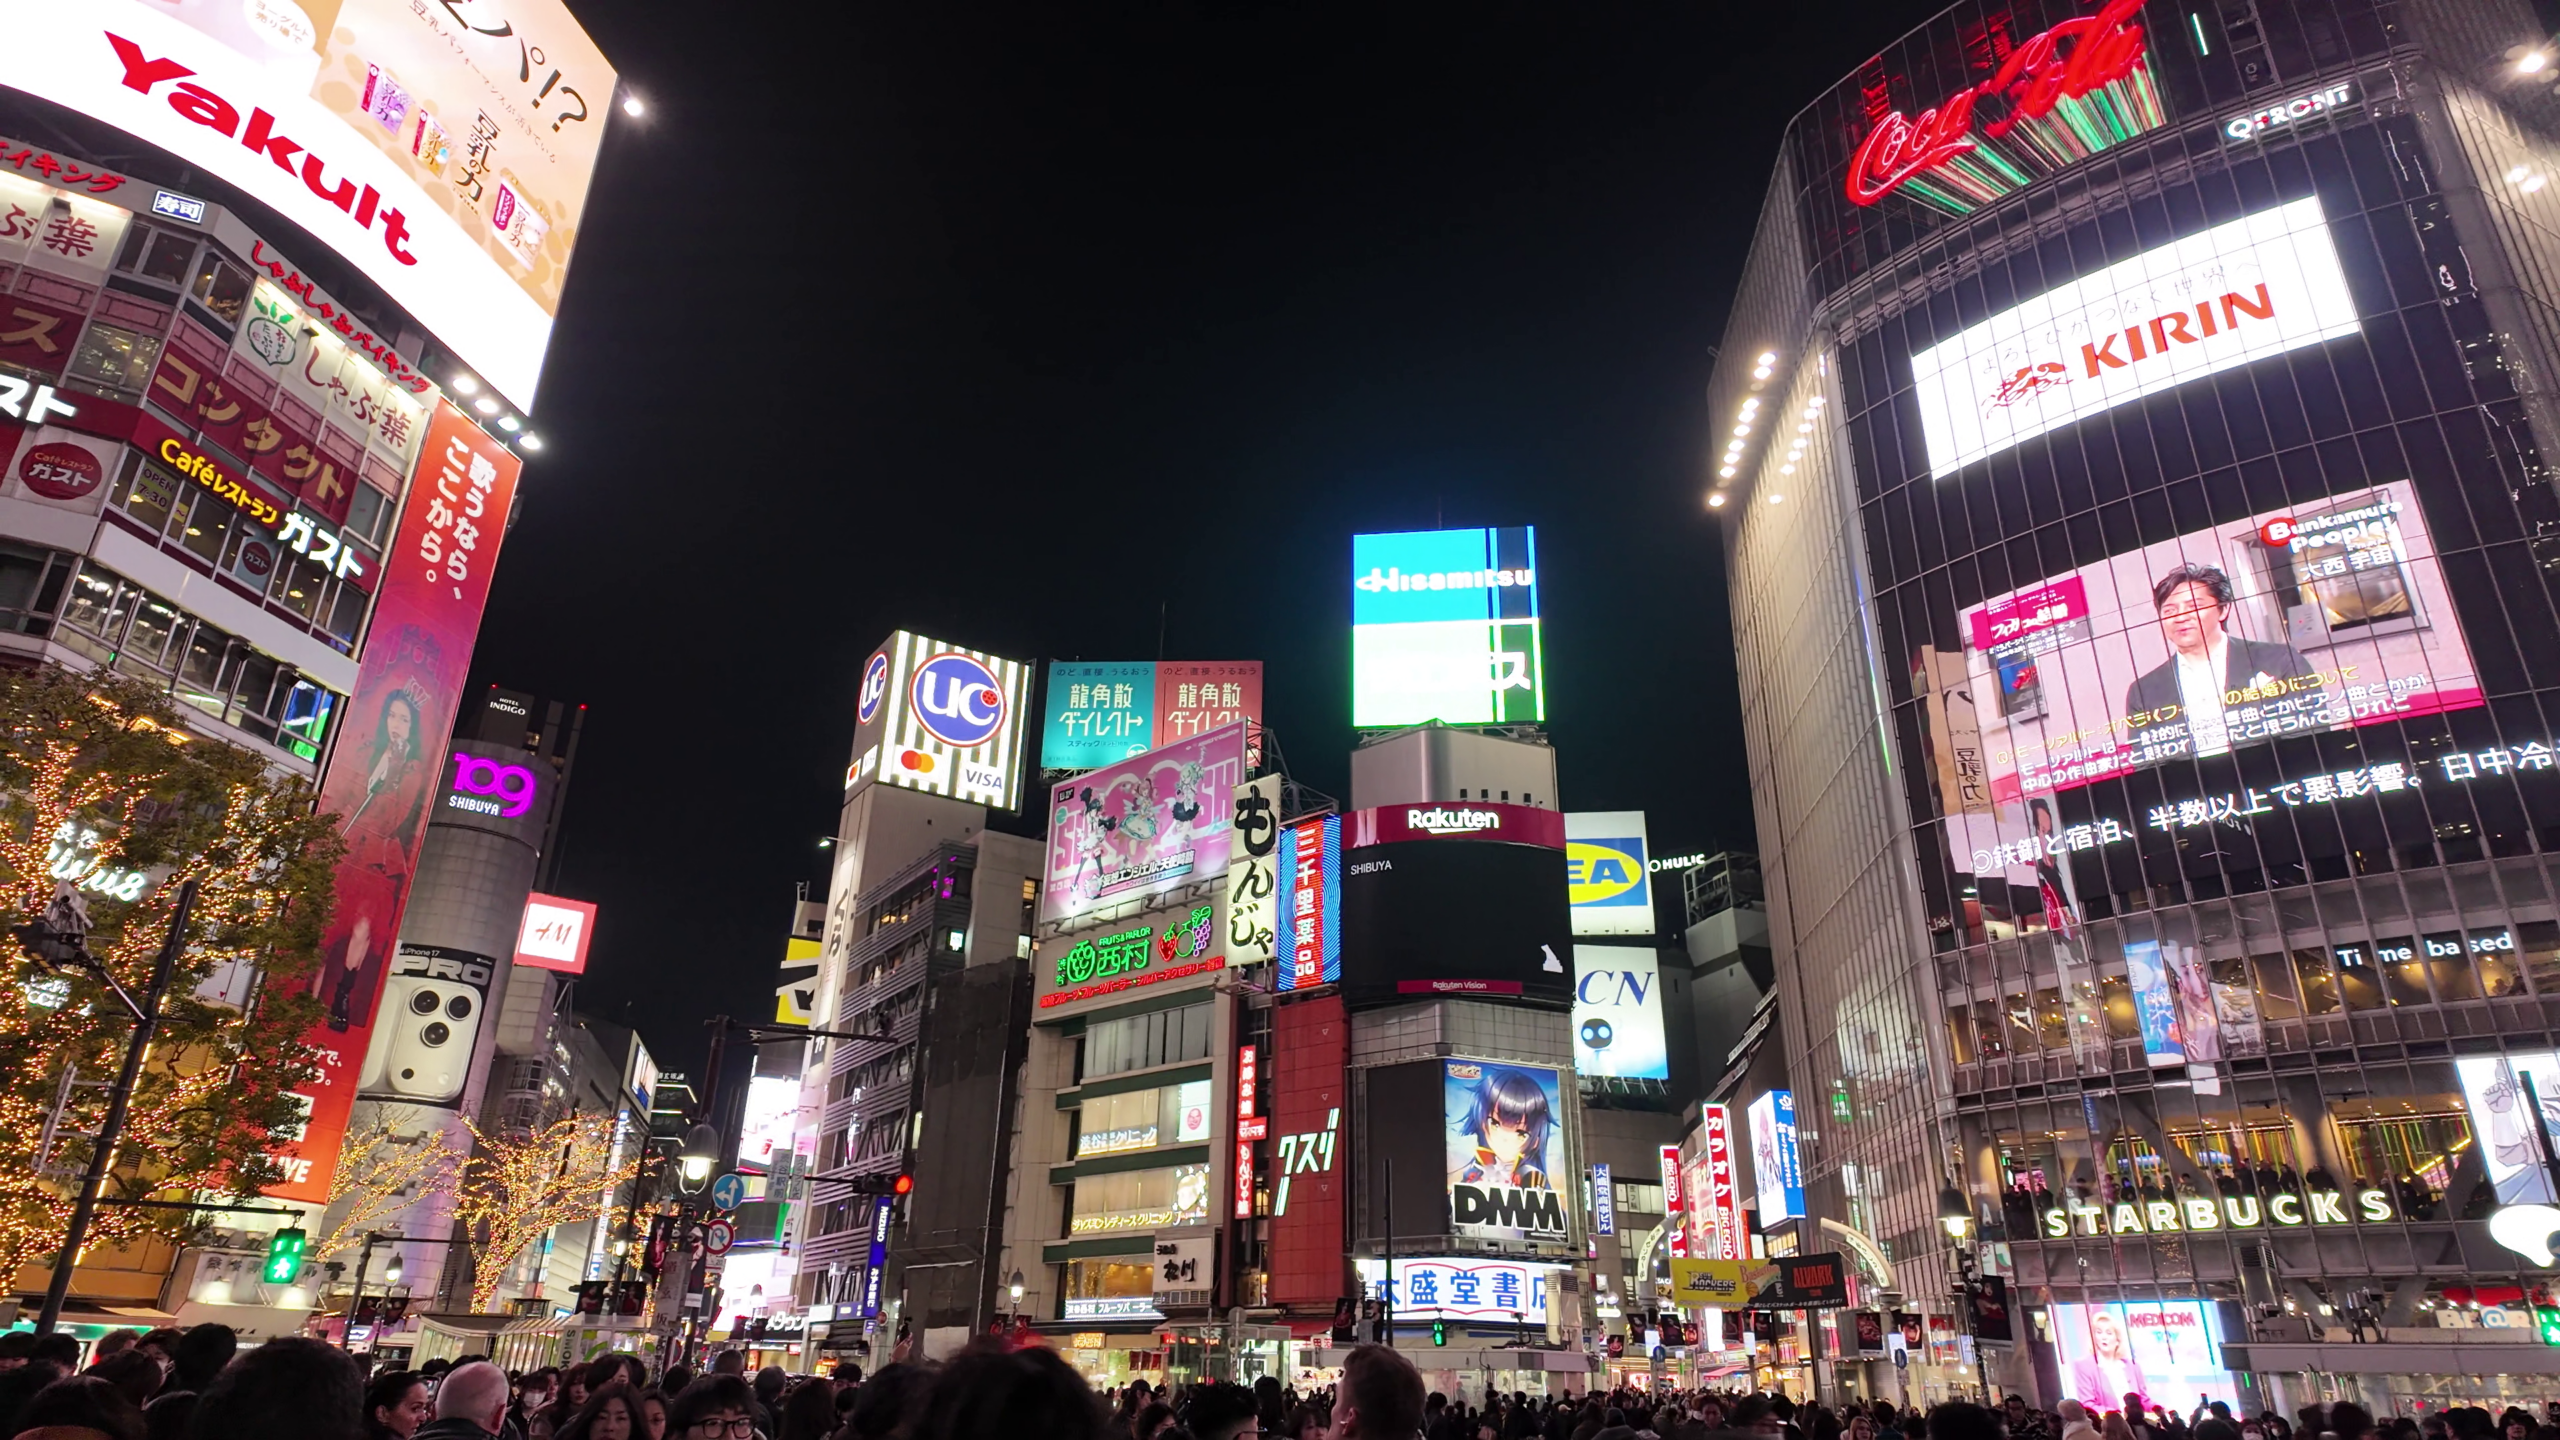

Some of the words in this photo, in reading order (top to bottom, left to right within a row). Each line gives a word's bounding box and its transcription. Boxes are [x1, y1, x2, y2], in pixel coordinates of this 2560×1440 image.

[2227, 84, 2349, 139] QFRONT
[103, 30, 418, 266] Yakult
[455, 108, 501, 203] 豆乳の力
[156, 194, 201, 220] 寿司
[251, 239, 433, 394] しゃぶしゃぶバイキング
[2081, 282, 2276, 379] KIRIN
[305, 345, 412, 448] しゃぶ葉
[155, 352, 345, 499] コンタクト
[28, 462, 92, 487] ガスト
[143, 468, 175, 493] OPEN
[161, 438, 278, 525] Caféレストラン
[420, 435, 470, 583] ここから。
[446, 451, 498, 600] 歌うなら、
[2268, 501, 2404, 541] Bunkamura
[277, 511, 364, 580] ガスト
[1356, 566, 1533, 593] Hisamitsu
[489, 701, 526, 716] INDIGO
[1070, 683, 1134, 709] 龍角散
[1178, 682, 1242, 708] 龍角散
[1059, 711, 1144, 737] ダイレクト
[965, 768, 1003, 790] VISA
[2442, 740, 2560, 783] 日中冷
[453, 752, 537, 818] 109
[449, 795, 500, 816] SHIBUYA
[1408, 807, 1499, 834] Rakuten
[1231, 784, 1276, 956] もんじゃ
[1350, 859, 1393, 875] SHIBUYA
[1661, 853, 1706, 869] HULIC
[1294, 828, 1317, 976] 三千里薬品
[394, 955, 490, 986] PRO
[404, 948, 431, 956] iPhone
[1097, 939, 1150, 977] 西村
[1432, 980, 1463, 990] Rakuten
[1463, 981, 1487, 989] Vision
[1577, 969, 1656, 1008] CN
[1274, 1107, 1341, 1217] クスリ
[1665, 1158, 1675, 1177] BIG
[1707, 1116, 1732, 1197] カラオケ
[1667, 1176, 1678, 1202] ECHO
[877, 1206, 889, 1243] MIZUHO
[1453, 1183, 1567, 1234] DMM
[1718, 1206, 1730, 1229] BIG
[2046, 1189, 2393, 1238] STARBUCKS
[1721, 1229, 1734, 1260] ECHO
[1792, 1264, 1834, 1289] ALVARK
[2129, 1312, 2196, 1328] MEDICOM
